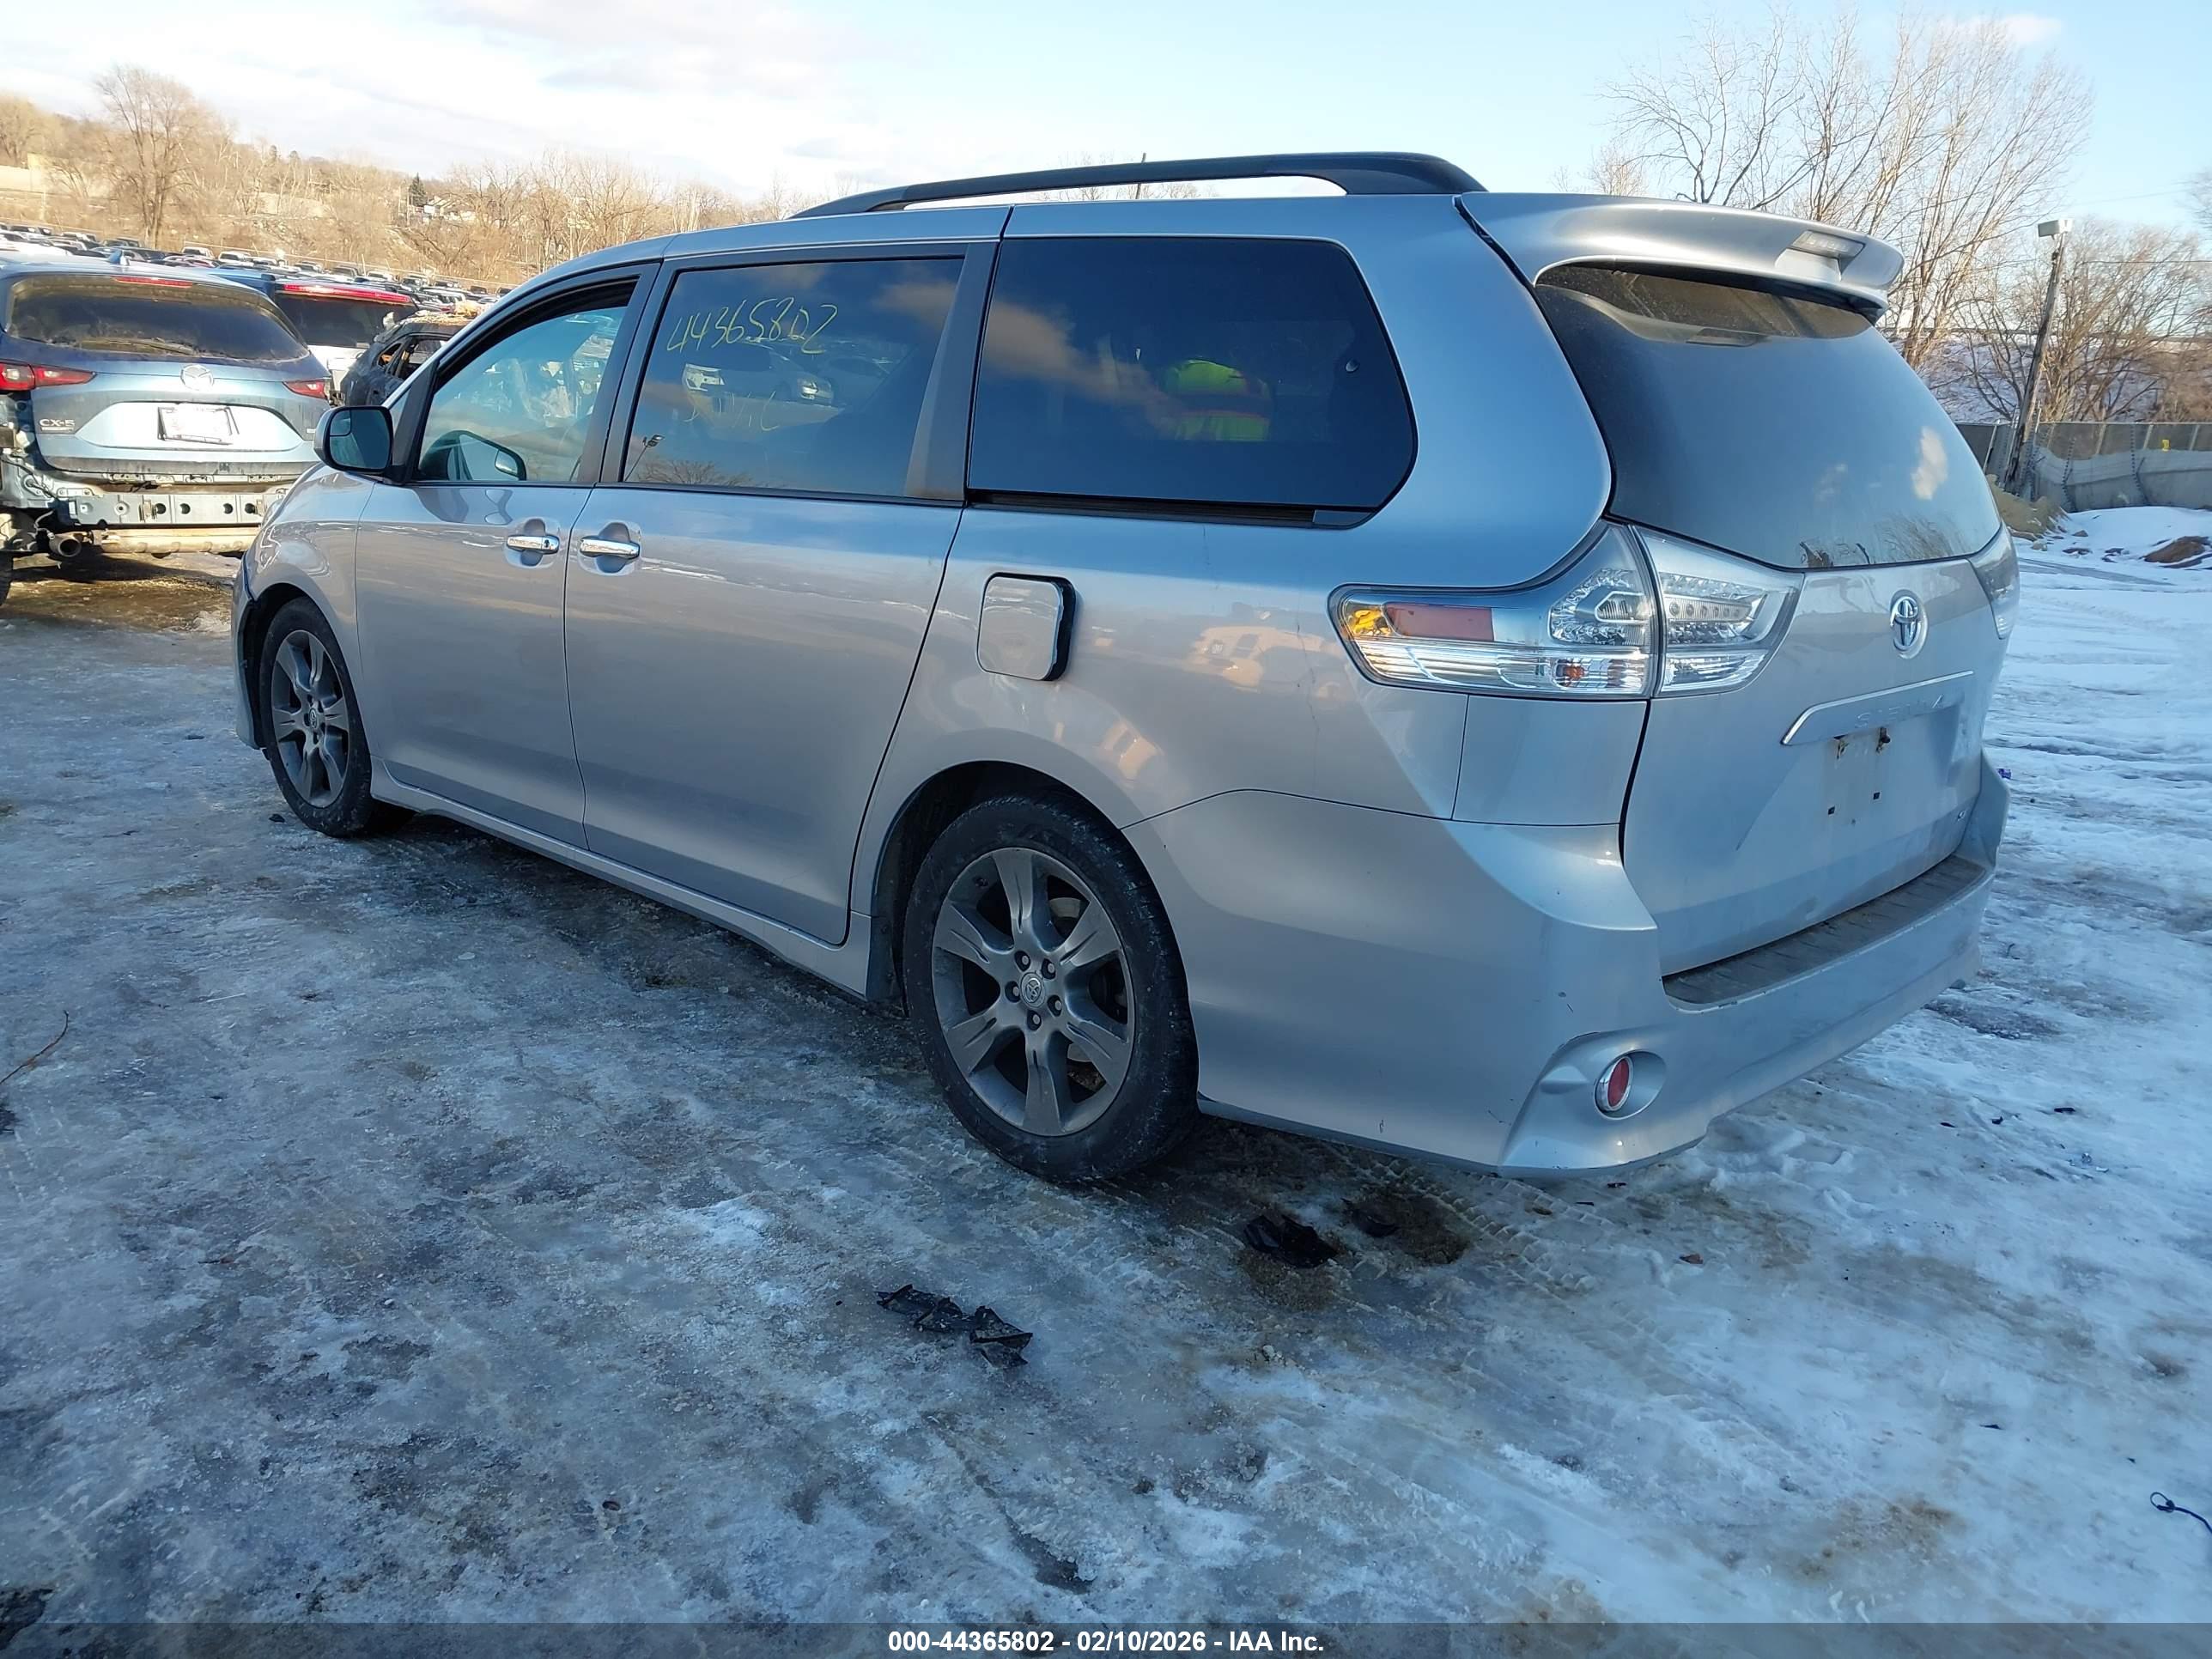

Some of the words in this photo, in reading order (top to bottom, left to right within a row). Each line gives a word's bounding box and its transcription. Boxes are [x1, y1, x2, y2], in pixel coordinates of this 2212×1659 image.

[666, 296, 838, 354] 44365802
[39, 418, 76, 427] CX-5
[1855, 693, 1948, 729] SIEA
